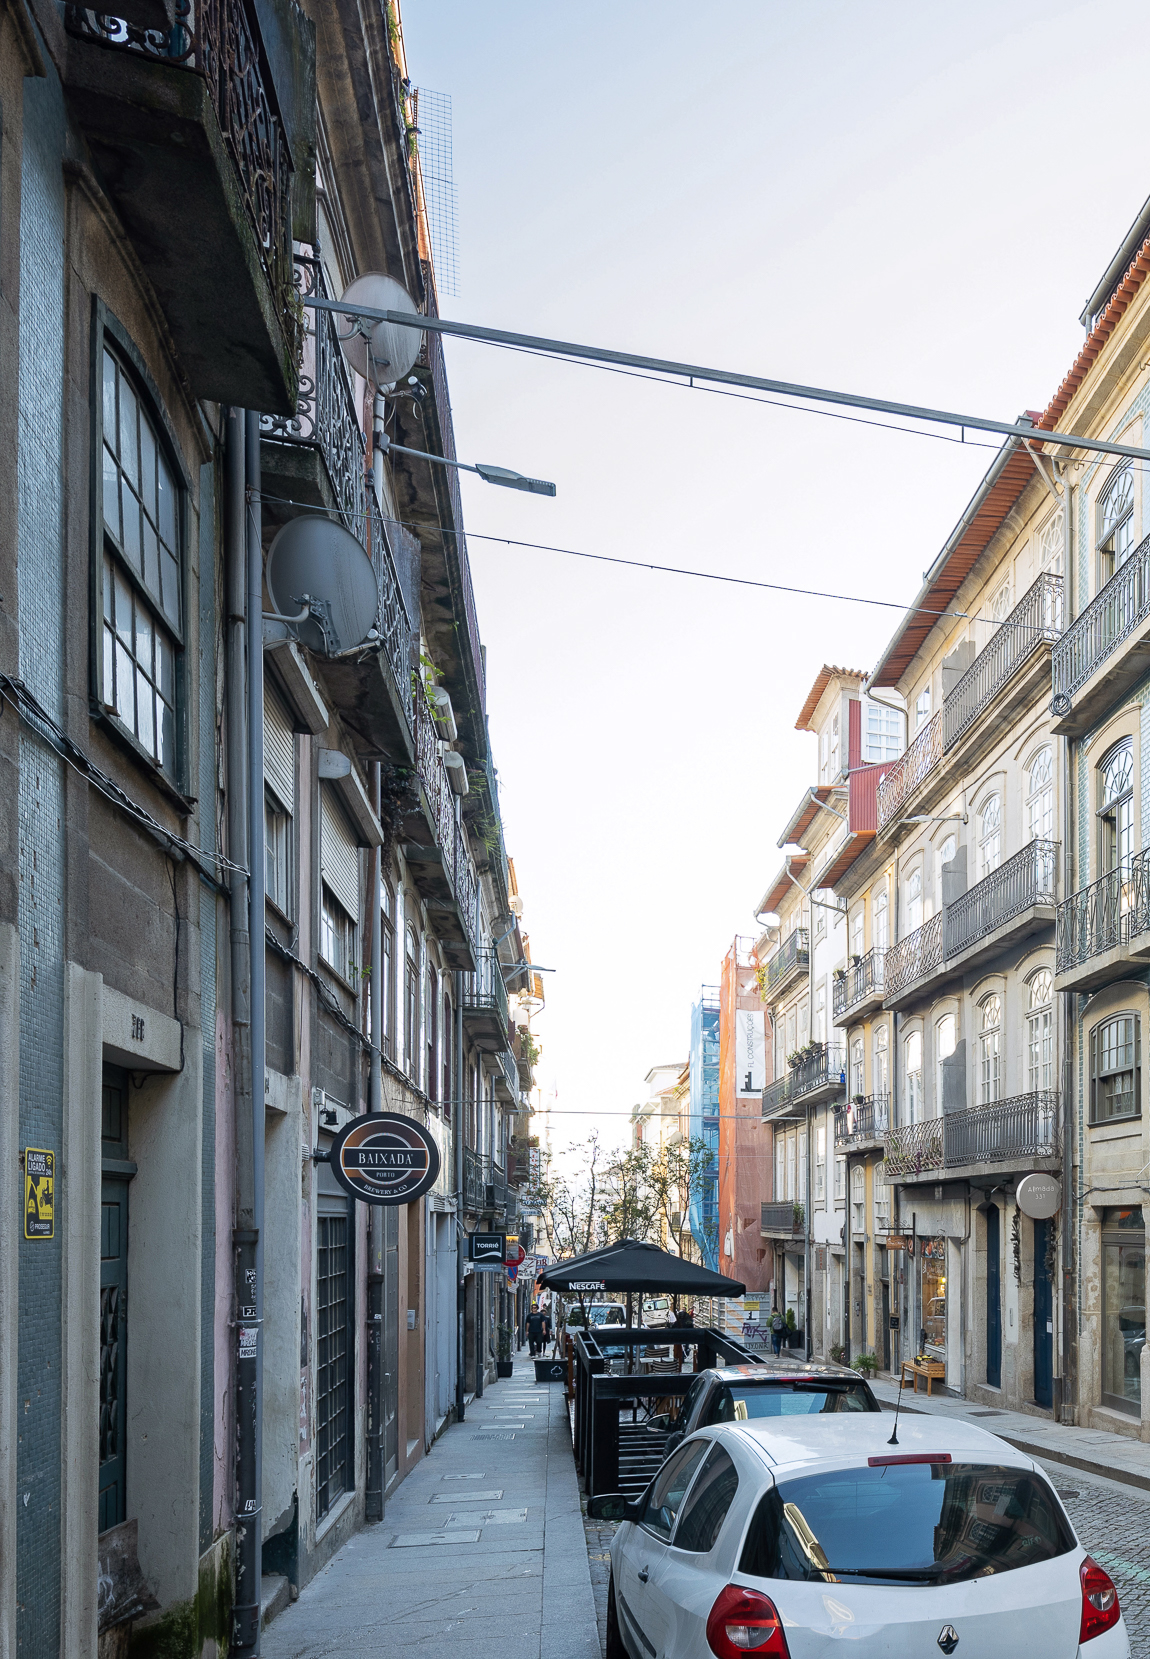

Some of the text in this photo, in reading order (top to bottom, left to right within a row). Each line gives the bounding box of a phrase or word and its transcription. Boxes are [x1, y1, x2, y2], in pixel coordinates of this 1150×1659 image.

[28, 1153, 46, 1163] ALARME
[358, 1152, 412, 1165] BAIXADA
[27, 1161, 46, 1172] LIGADO
[363, 1184, 393, 1195] BREWERY
[398, 1184, 408, 1192] CO
[568, 1280, 606, 1290] NESCAFÉ
